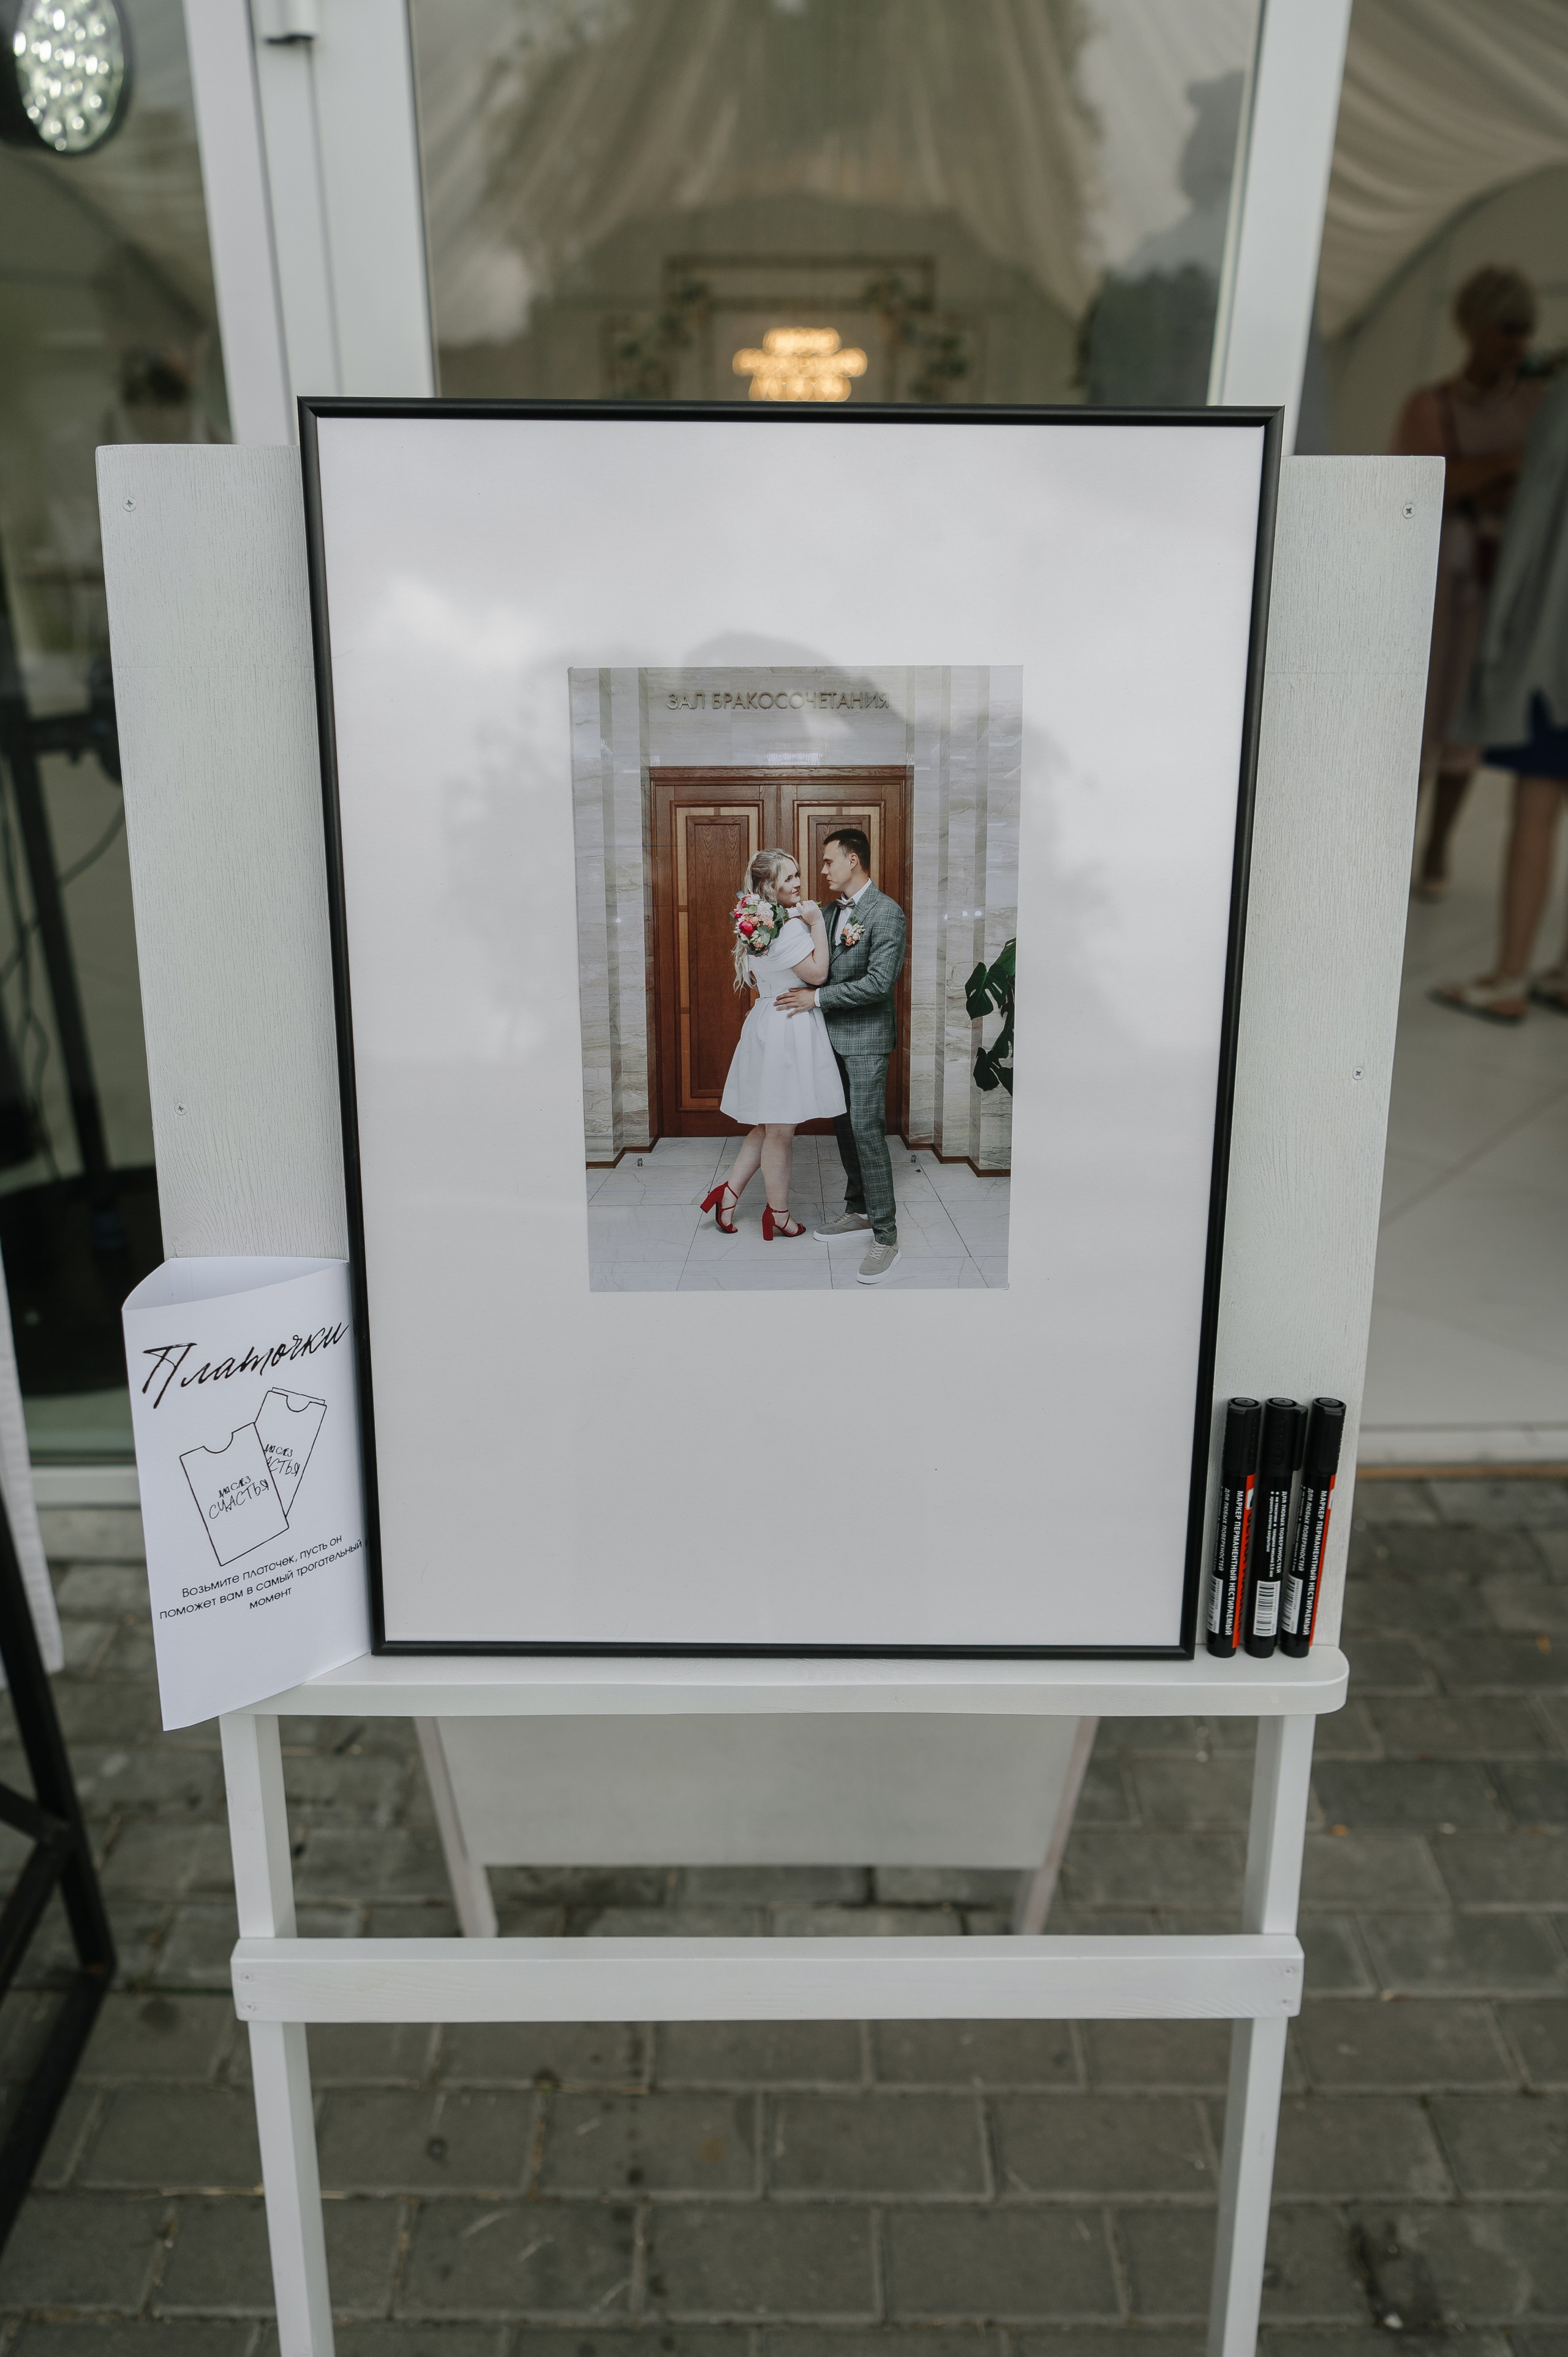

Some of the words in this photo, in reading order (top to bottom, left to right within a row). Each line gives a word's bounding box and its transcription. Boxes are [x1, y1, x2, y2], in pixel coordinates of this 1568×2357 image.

[667, 692, 706, 710] ЗАЛ
[712, 692, 889, 709] БРАКОСОЧЕТАНИЯ
[142, 1322, 350, 1409] Платочки
[1235, 1490, 1244, 1520] МАРКЕР
[1317, 1490, 1328, 1520] МАРКЕР
[182, 1575, 239, 1597] Возьмите
[243, 1555, 298, 1580] платочек,
[300, 1543, 328, 1559] пусть
[330, 1535, 342, 1546] он
[1229, 1521, 1241, 1581] ПЕРМАНЕНТНЫЙ
[1276, 1527, 1284, 1574] ПОВЕРХНОСТЕЙ
[1298, 1525, 1309, 1571] ПОВЕРХНОСТЕЙ
[1309, 1521, 1324, 1581] ПЕРМАНЕНТНЫЙ
[160, 1598, 216, 1619] поможет
[220, 1590, 243, 1604] вам
[246, 1586, 254, 1595] в
[256, 1570, 294, 1591] самый
[296, 1539, 363, 1577] трогательный
[249, 1587, 292, 1609] момент
[1224, 1582, 1236, 1635] НЕСТИРАЕМЫЙ
[1302, 1582, 1316, 1635] НЕСТИРАЕМЫЙ
